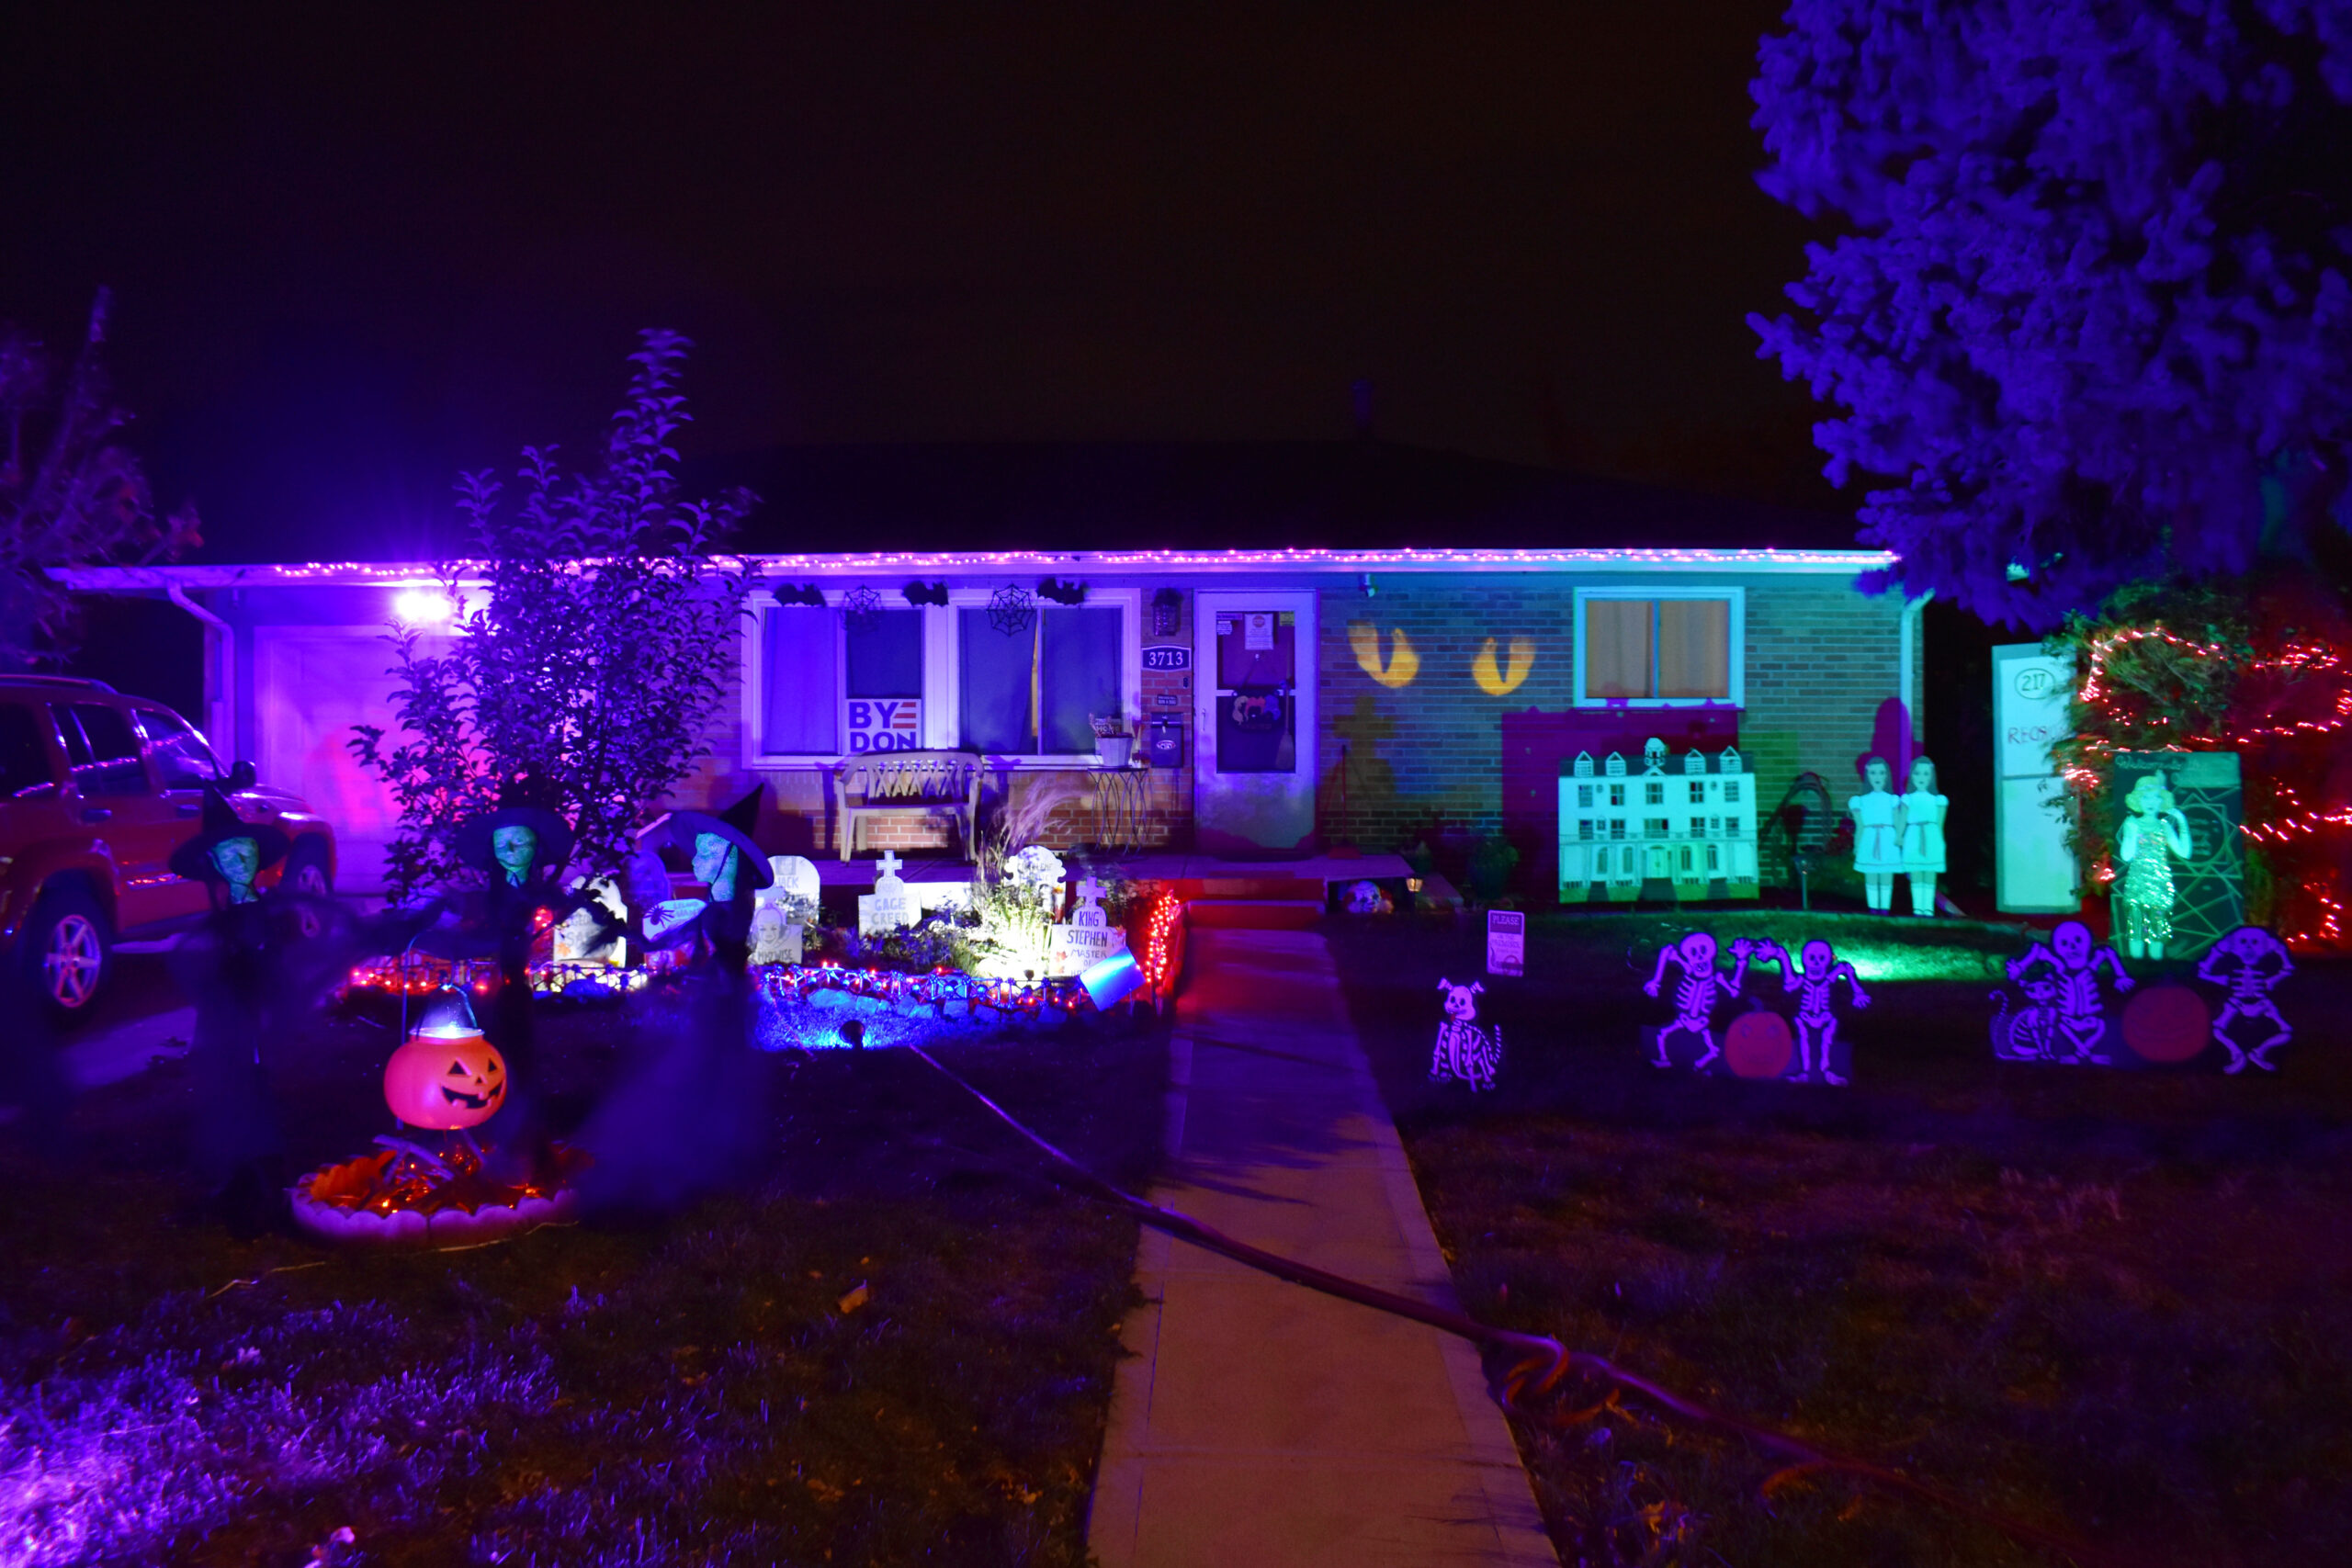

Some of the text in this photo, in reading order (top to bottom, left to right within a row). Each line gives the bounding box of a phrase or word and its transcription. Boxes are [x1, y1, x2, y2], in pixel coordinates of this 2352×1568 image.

[1148, 650, 1184, 667] 3713
[2021, 673, 2047, 692] 217
[849, 702, 917, 728] BYE
[850, 731, 917, 751] DON
[874, 897, 907, 911] GAGE
[871, 911, 910, 926] CREED
[1079, 910, 1100, 927] KING
[1492, 915, 1521, 926] PLEASE
[1066, 929, 1108, 947] STEPHEN
[1070, 949, 1107, 959] MASTER
